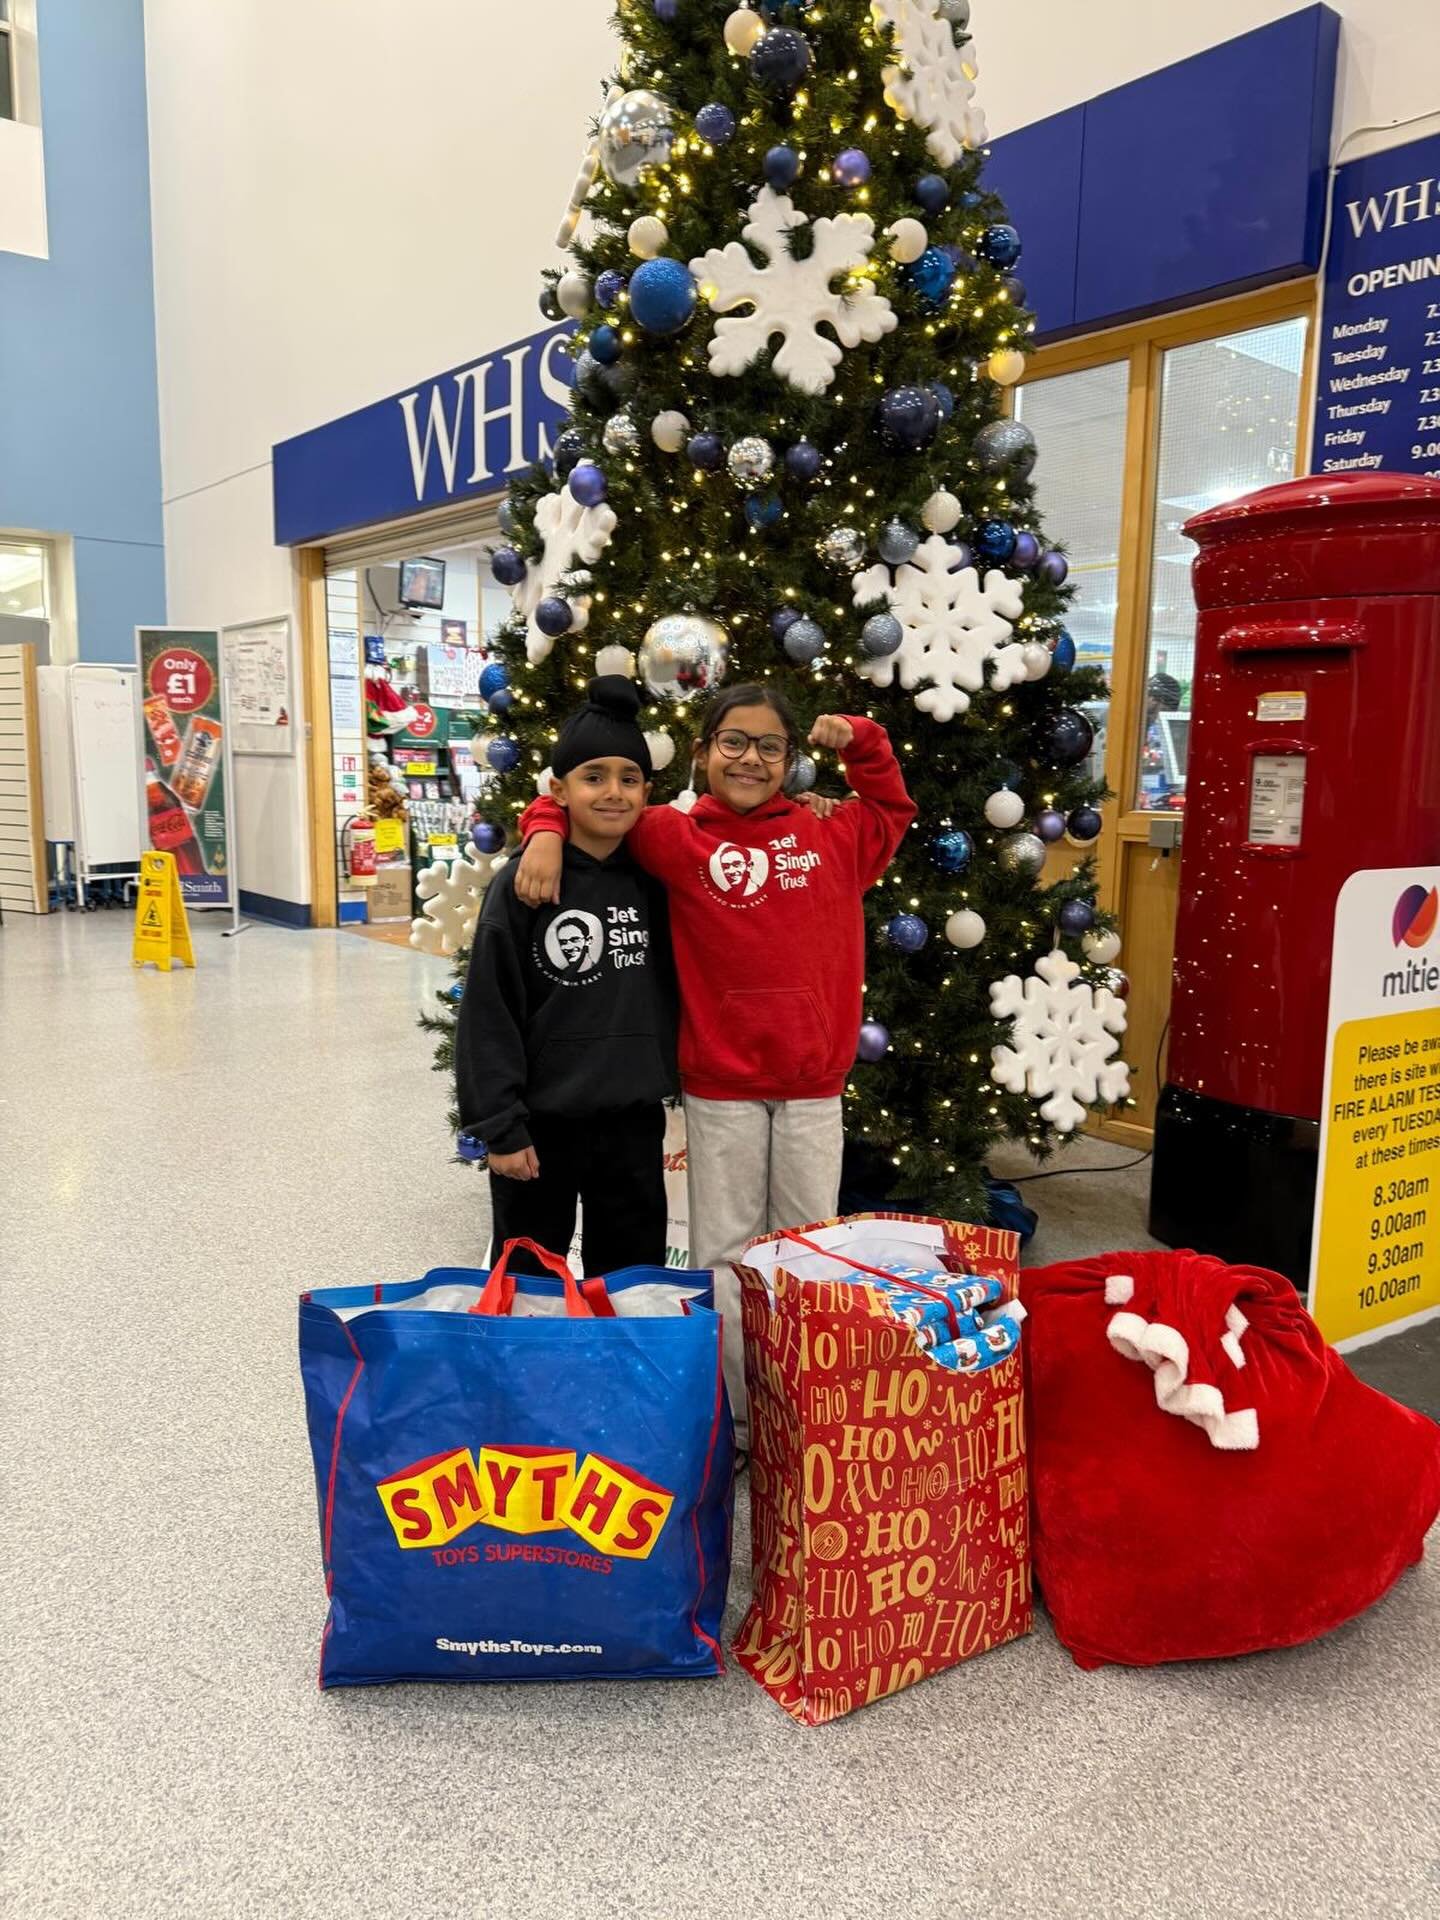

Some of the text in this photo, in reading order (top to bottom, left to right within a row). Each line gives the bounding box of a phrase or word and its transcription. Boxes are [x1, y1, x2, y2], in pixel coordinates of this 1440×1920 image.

[1345, 178, 1440, 238] WH
[1332, 316, 1389, 339] Monday
[1331, 344, 1387, 365] Tuesday
[1329, 366, 1411, 392] Wednesday
[1327, 397, 1392, 419] Thursday
[1324, 428, 1366, 446] Friday
[1322, 452, 1384, 472] Saturday
[163, 658, 197, 672] Only
[166, 673, 196, 694] £1
[767, 833, 798, 850] Jet
[774, 850, 821, 872] Singh
[774, 872, 808, 890] Trust
[607, 906, 640, 924] Jet
[1382, 957, 1440, 997] mitie
[1358, 1044, 1400, 1065] Please
[1404, 1039, 1419, 1055] be
[1354, 1073, 1387, 1092] there
[1390, 1068, 1401, 1084] is
[1405, 1063, 1427, 1081] site
[1333, 1099, 1365, 1122] FIRE
[1369, 1089, 1415, 1114] ALARM
[1353, 1123, 1388, 1143] every
[1355, 1151, 1368, 1169] at
[1371, 1144, 1405, 1165] these
[1374, 1177, 1429, 1207] 8.30am
[1371, 1209, 1426, 1240] 9.00am
[1368, 1242, 1424, 1274] 9.30am
[1358, 1274, 1421, 1309] 10.00am
[846, 1327, 897, 1369] HO
[811, 1384, 848, 1425] HO
[863, 1368, 931, 1419] HO
[931, 1386, 988, 1426] ho
[837, 1424, 989, 1496] HO ho HO
[901, 1461, 950, 1508] HO
[390, 1461, 665, 1551] SMYTHS
[860, 1507, 931, 1557] HO
[432, 1544, 613, 1576] TOYS SUPERSTORES
[817, 1568, 858, 1619] HO
[866, 1554, 937, 1617] HO
[435, 1637, 603, 1656] SmythsToys.com
[850, 1619, 895, 1668] HO
[899, 1611, 925, 1649] HO
[922, 1599, 987, 1658] HO
